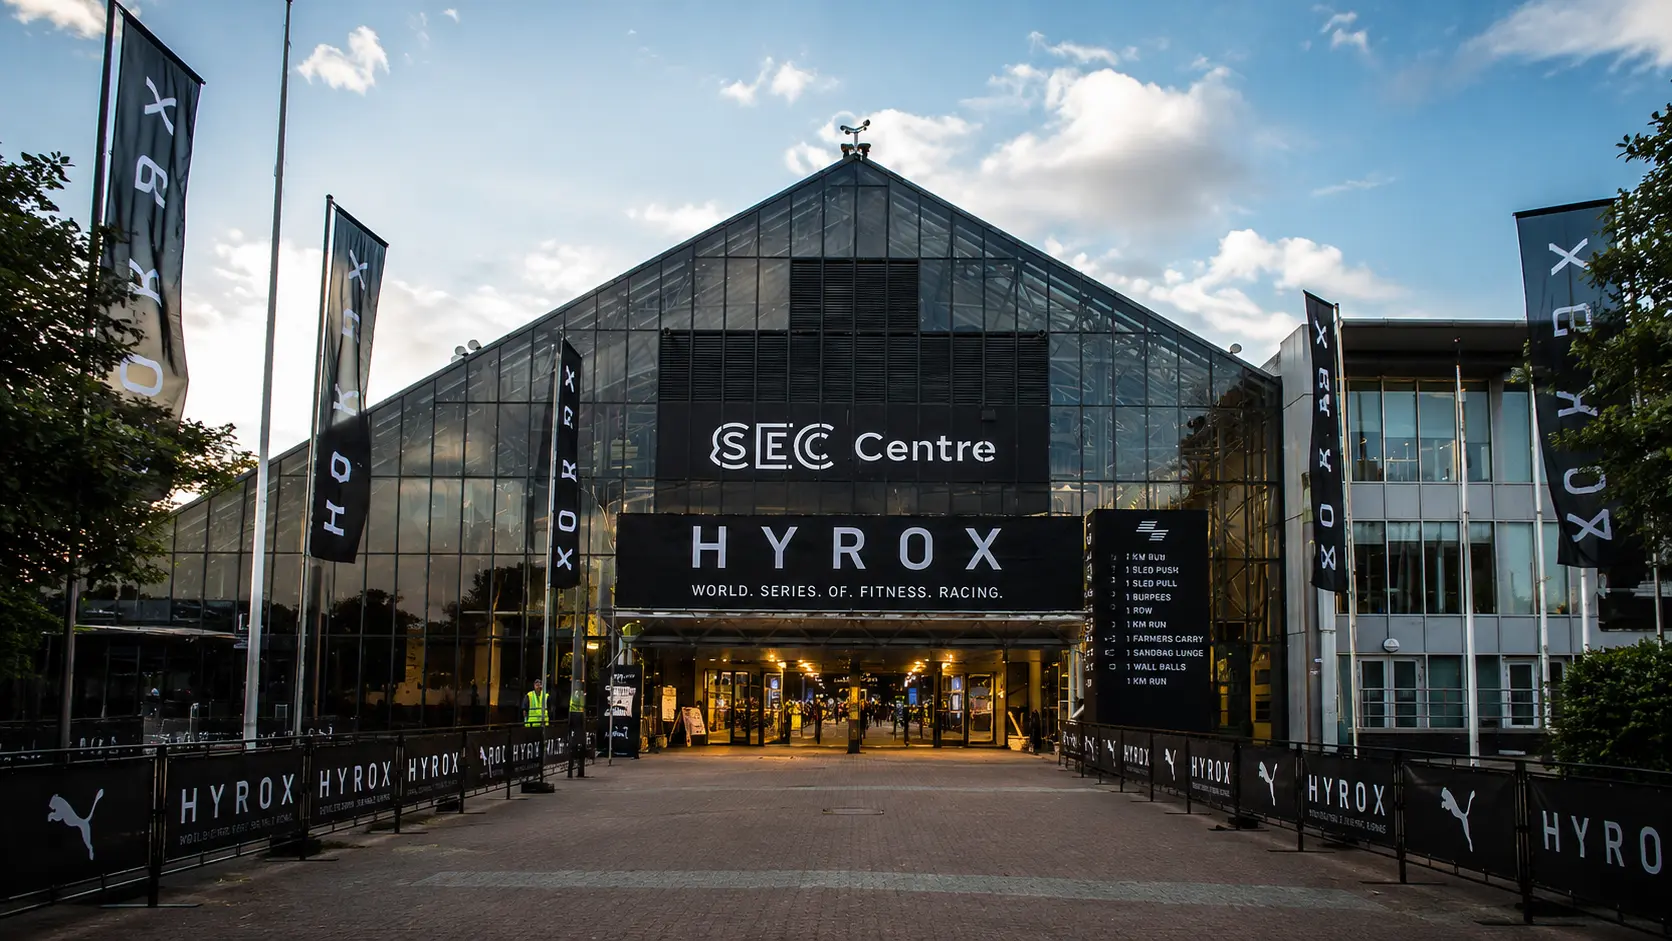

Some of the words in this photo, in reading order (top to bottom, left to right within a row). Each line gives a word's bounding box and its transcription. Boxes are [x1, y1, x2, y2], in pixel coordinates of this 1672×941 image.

[709, 422, 835, 470] SEC
[854, 432, 996, 462] Centre
[692, 525, 1002, 571] HYROX
[1132, 565, 1154, 574] SLED
[1132, 579, 1154, 587] SLED
[1156, 579, 1178, 587] PULL
[691, 584, 753, 598] WORLD.
[760, 584, 822, 598] SERIES.
[828, 585, 853, 598] OF.
[860, 585, 932, 599] FITNESS.
[939, 586, 1003, 599] RACING.
[1132, 593, 1172, 601] BURPEES
[1133, 606, 1153, 614] ROW
[1132, 620, 1147, 628] KM
[1148, 620, 1167, 629] RUN
[1132, 635, 1173, 643] FARMERS
[1175, 635, 1204, 643] CARRY
[1133, 649, 1173, 657] SANDBAG
[1175, 649, 1204, 657] LUNGE
[1133, 663, 1157, 671] WALL
[1159, 663, 1187, 671] BALLS
[1133, 677, 1147, 685] KM
[1149, 677, 1167, 686] RUN
[408, 751, 459, 782] HYROX
[1191, 755, 1231, 785] HYROX
[319, 760, 391, 799] HYROX
[180, 773, 295, 824] HYROX
[1308, 774, 1386, 817] HYROX
[1542, 810, 1663, 875] HYRO
